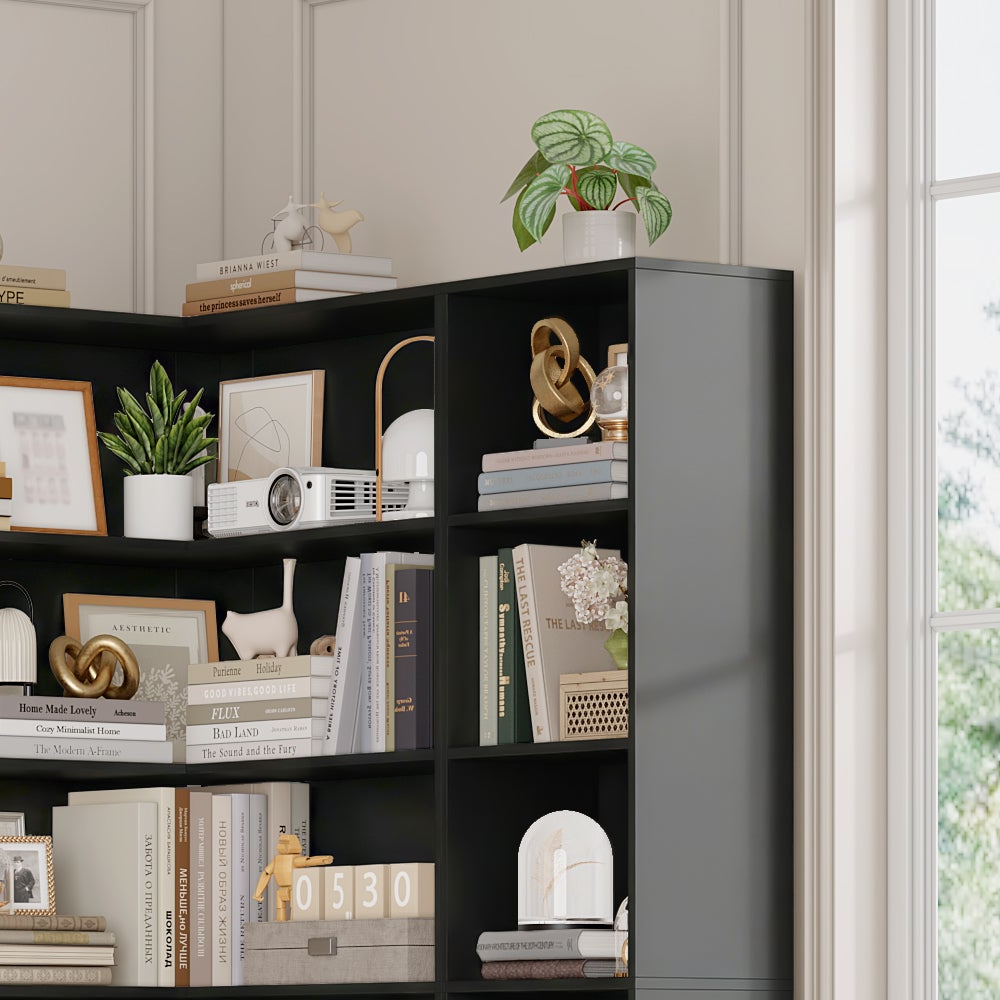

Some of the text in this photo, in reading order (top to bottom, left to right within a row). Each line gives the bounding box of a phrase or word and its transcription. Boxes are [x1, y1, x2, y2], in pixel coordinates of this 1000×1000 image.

[219, 259, 279, 275] BRIANNA WIEST
[515, 558, 526, 585] THE
[518, 587, 529, 614] LAST
[112, 624, 172, 634] AESTHETIC
[522, 620, 536, 668] RESCUE
[498, 603, 511, 718] Sympathy Humans
[212, 661, 283, 678] Purienne Holiday
[204, 688, 226, 699] GOOD
[252, 685, 275, 696] GOOD
[277, 684, 297, 695] LIFE
[19, 703, 136, 719] Home Made Lovely Acheson
[211, 706, 240, 721] FLUX
[36, 725, 121, 736] Cozy Minimalist Home
[213, 726, 259, 740] BAD LAND
[34, 744, 122, 757] The Modern A-Frame
[201, 743, 297, 760] The Sound and the Fury
[143, 834, 152, 964] ЗАБОТА О ПРЕДАННЫХ
[218, 821, 228, 964] НОВЫЙ ОБРАЗ ЖИЗНИ
[296, 870, 410, 911] 0 5 3 0
[164, 910, 173, 968] ШОКОЛАД
[178, 932, 188, 969] ЛУЧШЕ
